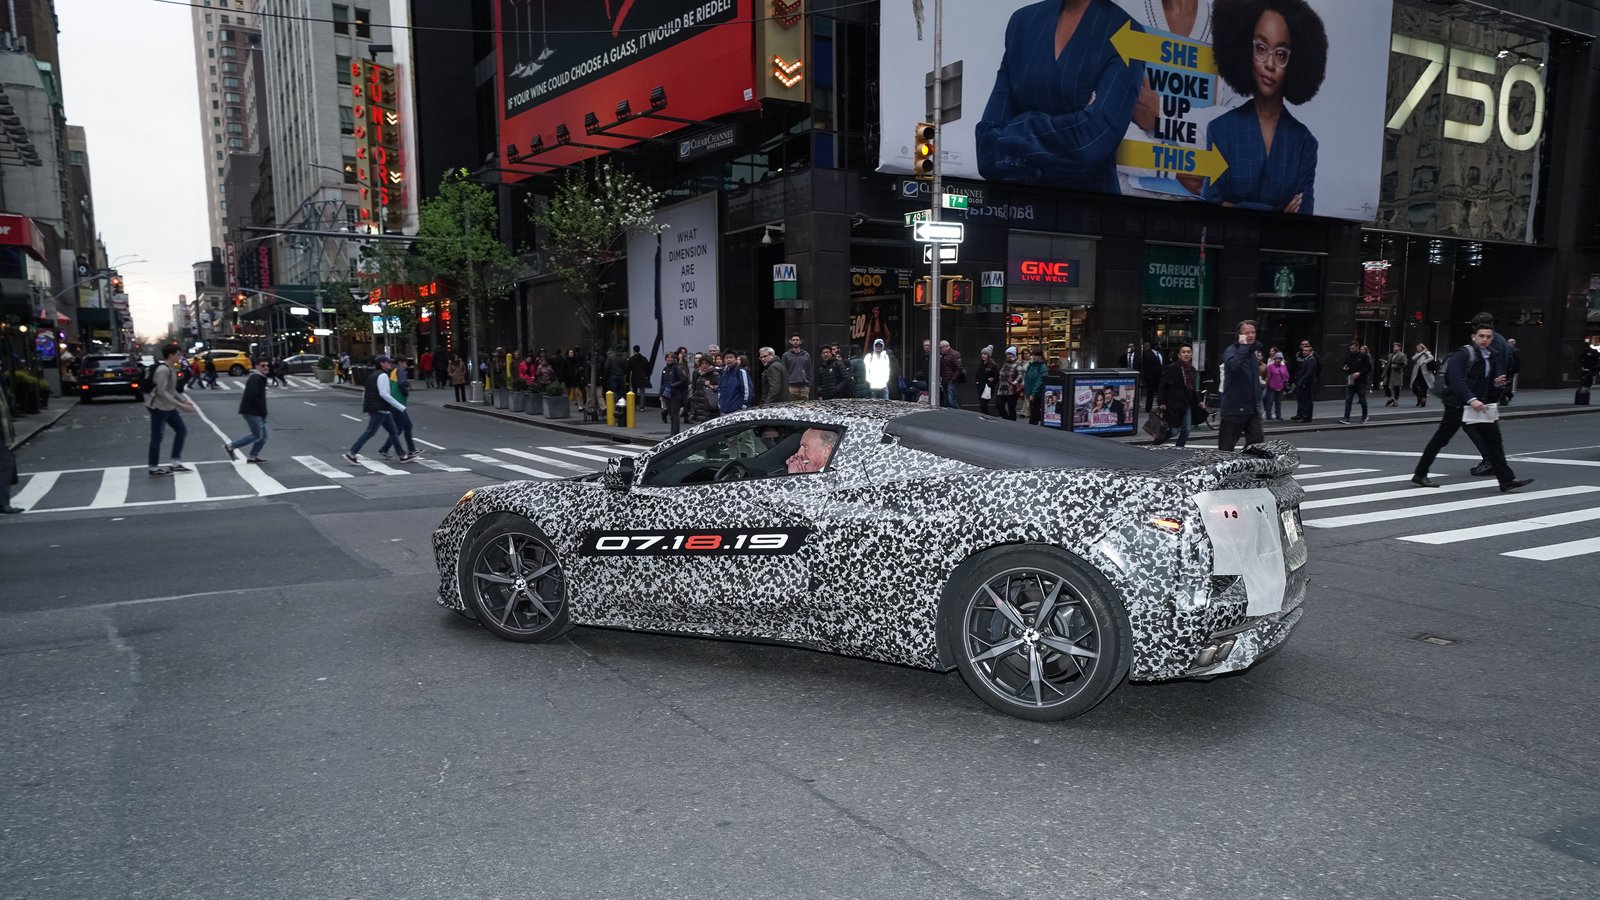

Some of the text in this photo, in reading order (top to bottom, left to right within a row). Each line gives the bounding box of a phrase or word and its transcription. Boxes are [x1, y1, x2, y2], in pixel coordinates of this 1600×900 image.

[507, 0, 731, 110] IF YOUR WINE COULD CHOOSE A GLASS, IT WOULD BE RIEDEL!
[1160, 40, 1198, 68] SHE
[1146, 67, 1209, 100] WOKE
[1386, 33, 1545, 151] 750
[1162, 95, 1191, 119] UP
[1154, 117, 1197, 144] LIKE
[351, 63, 369, 219] BROOKLYN
[1152, 145, 1196, 172] THIS
[951, 196, 957, 207] 7
[905, 214, 911, 226] W
[912, 212, 921, 222] 49
[677, 228, 698, 243] WHAT
[669, 244, 707, 262] DIMENSION
[258, 245, 271, 290] HICAGO
[680, 263, 695, 277] ARE
[850, 266, 887, 274] ubway Station
[1021, 260, 1069, 276] GNC
[680, 281, 696, 293] YOU
[1045, 275, 1068, 283] WELL
[1159, 276, 1196, 289] COFFEE
[679, 297, 698, 310] EVEN
[683, 315, 694, 327] IN?
[595, 533, 789, 550] 07.18.19
